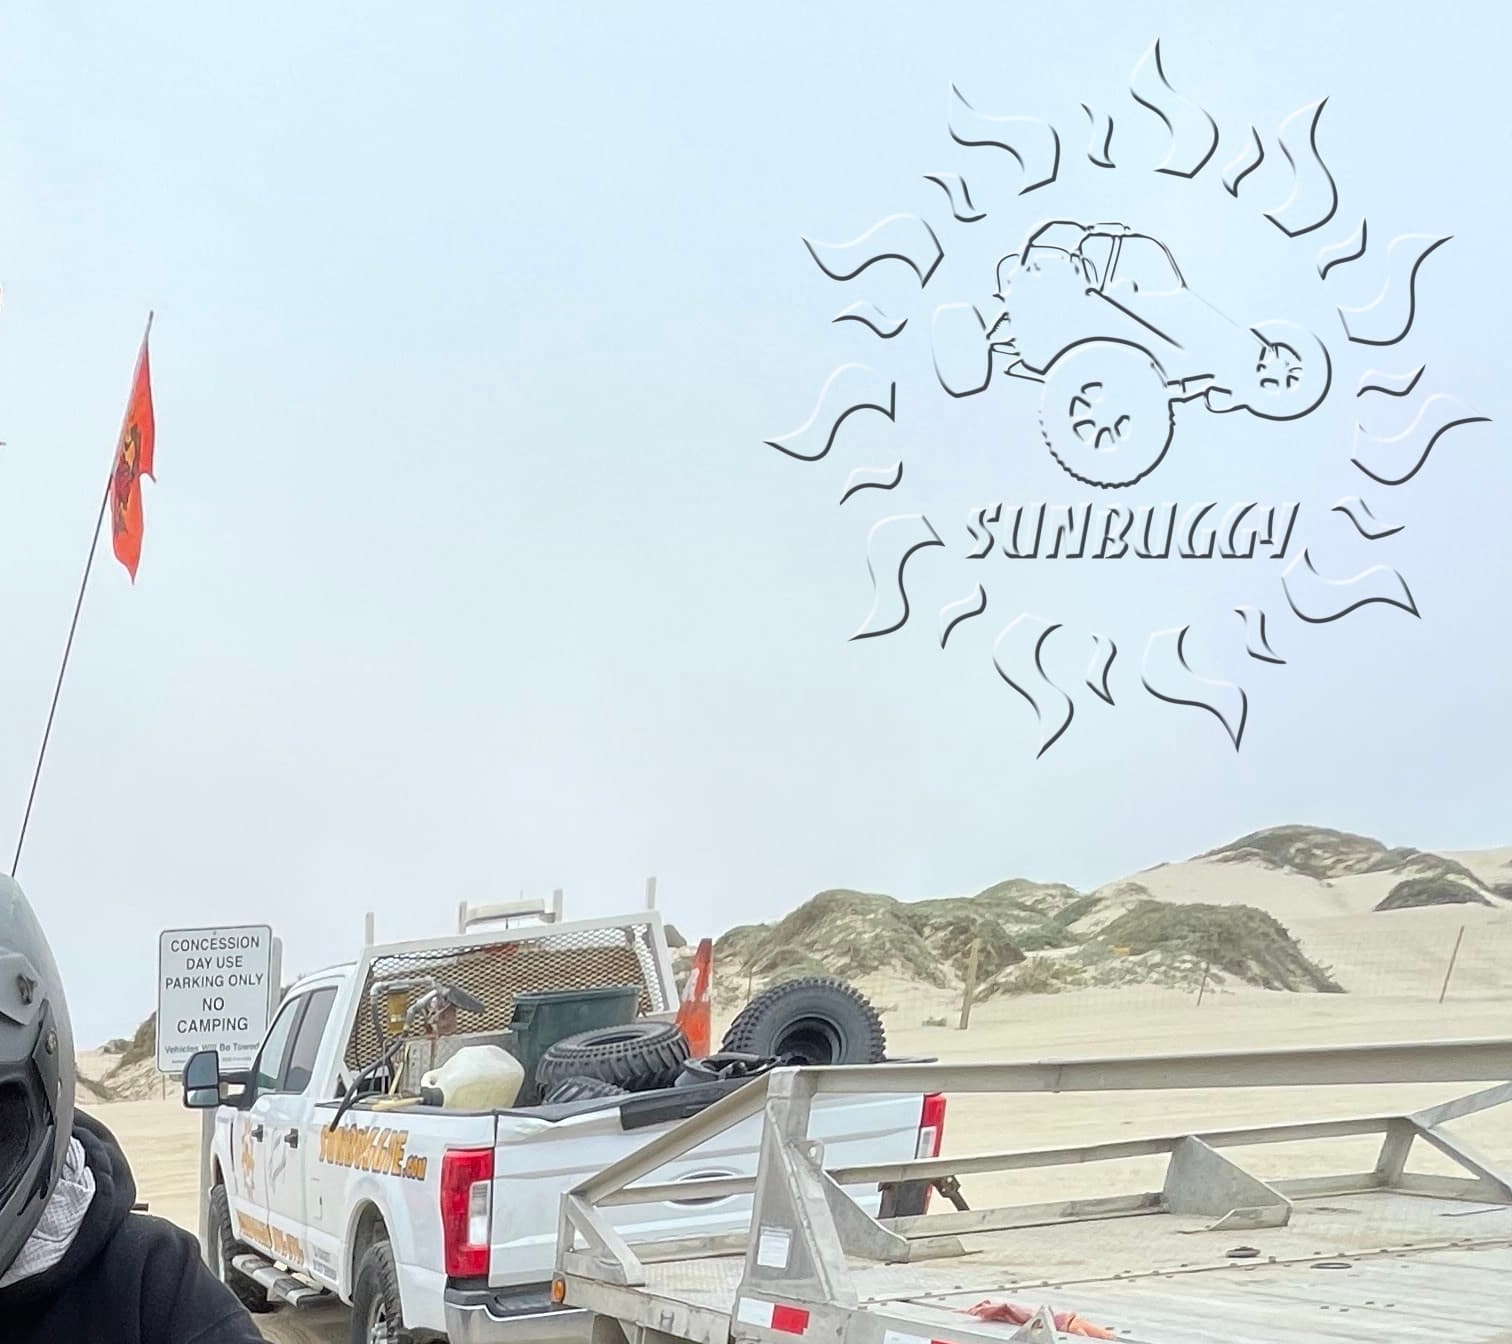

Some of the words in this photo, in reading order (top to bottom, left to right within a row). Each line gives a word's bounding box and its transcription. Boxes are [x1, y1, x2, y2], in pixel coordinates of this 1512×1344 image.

[170, 936, 260, 953] CONCESSION
[186, 957, 213, 971] DAY
[216, 955, 244, 969] USE
[165, 976, 224, 990] PARKING
[228, 973, 264, 987] ONLY
[202, 997, 225, 1012] NO
[177, 1017, 249, 1034] CAMPING
